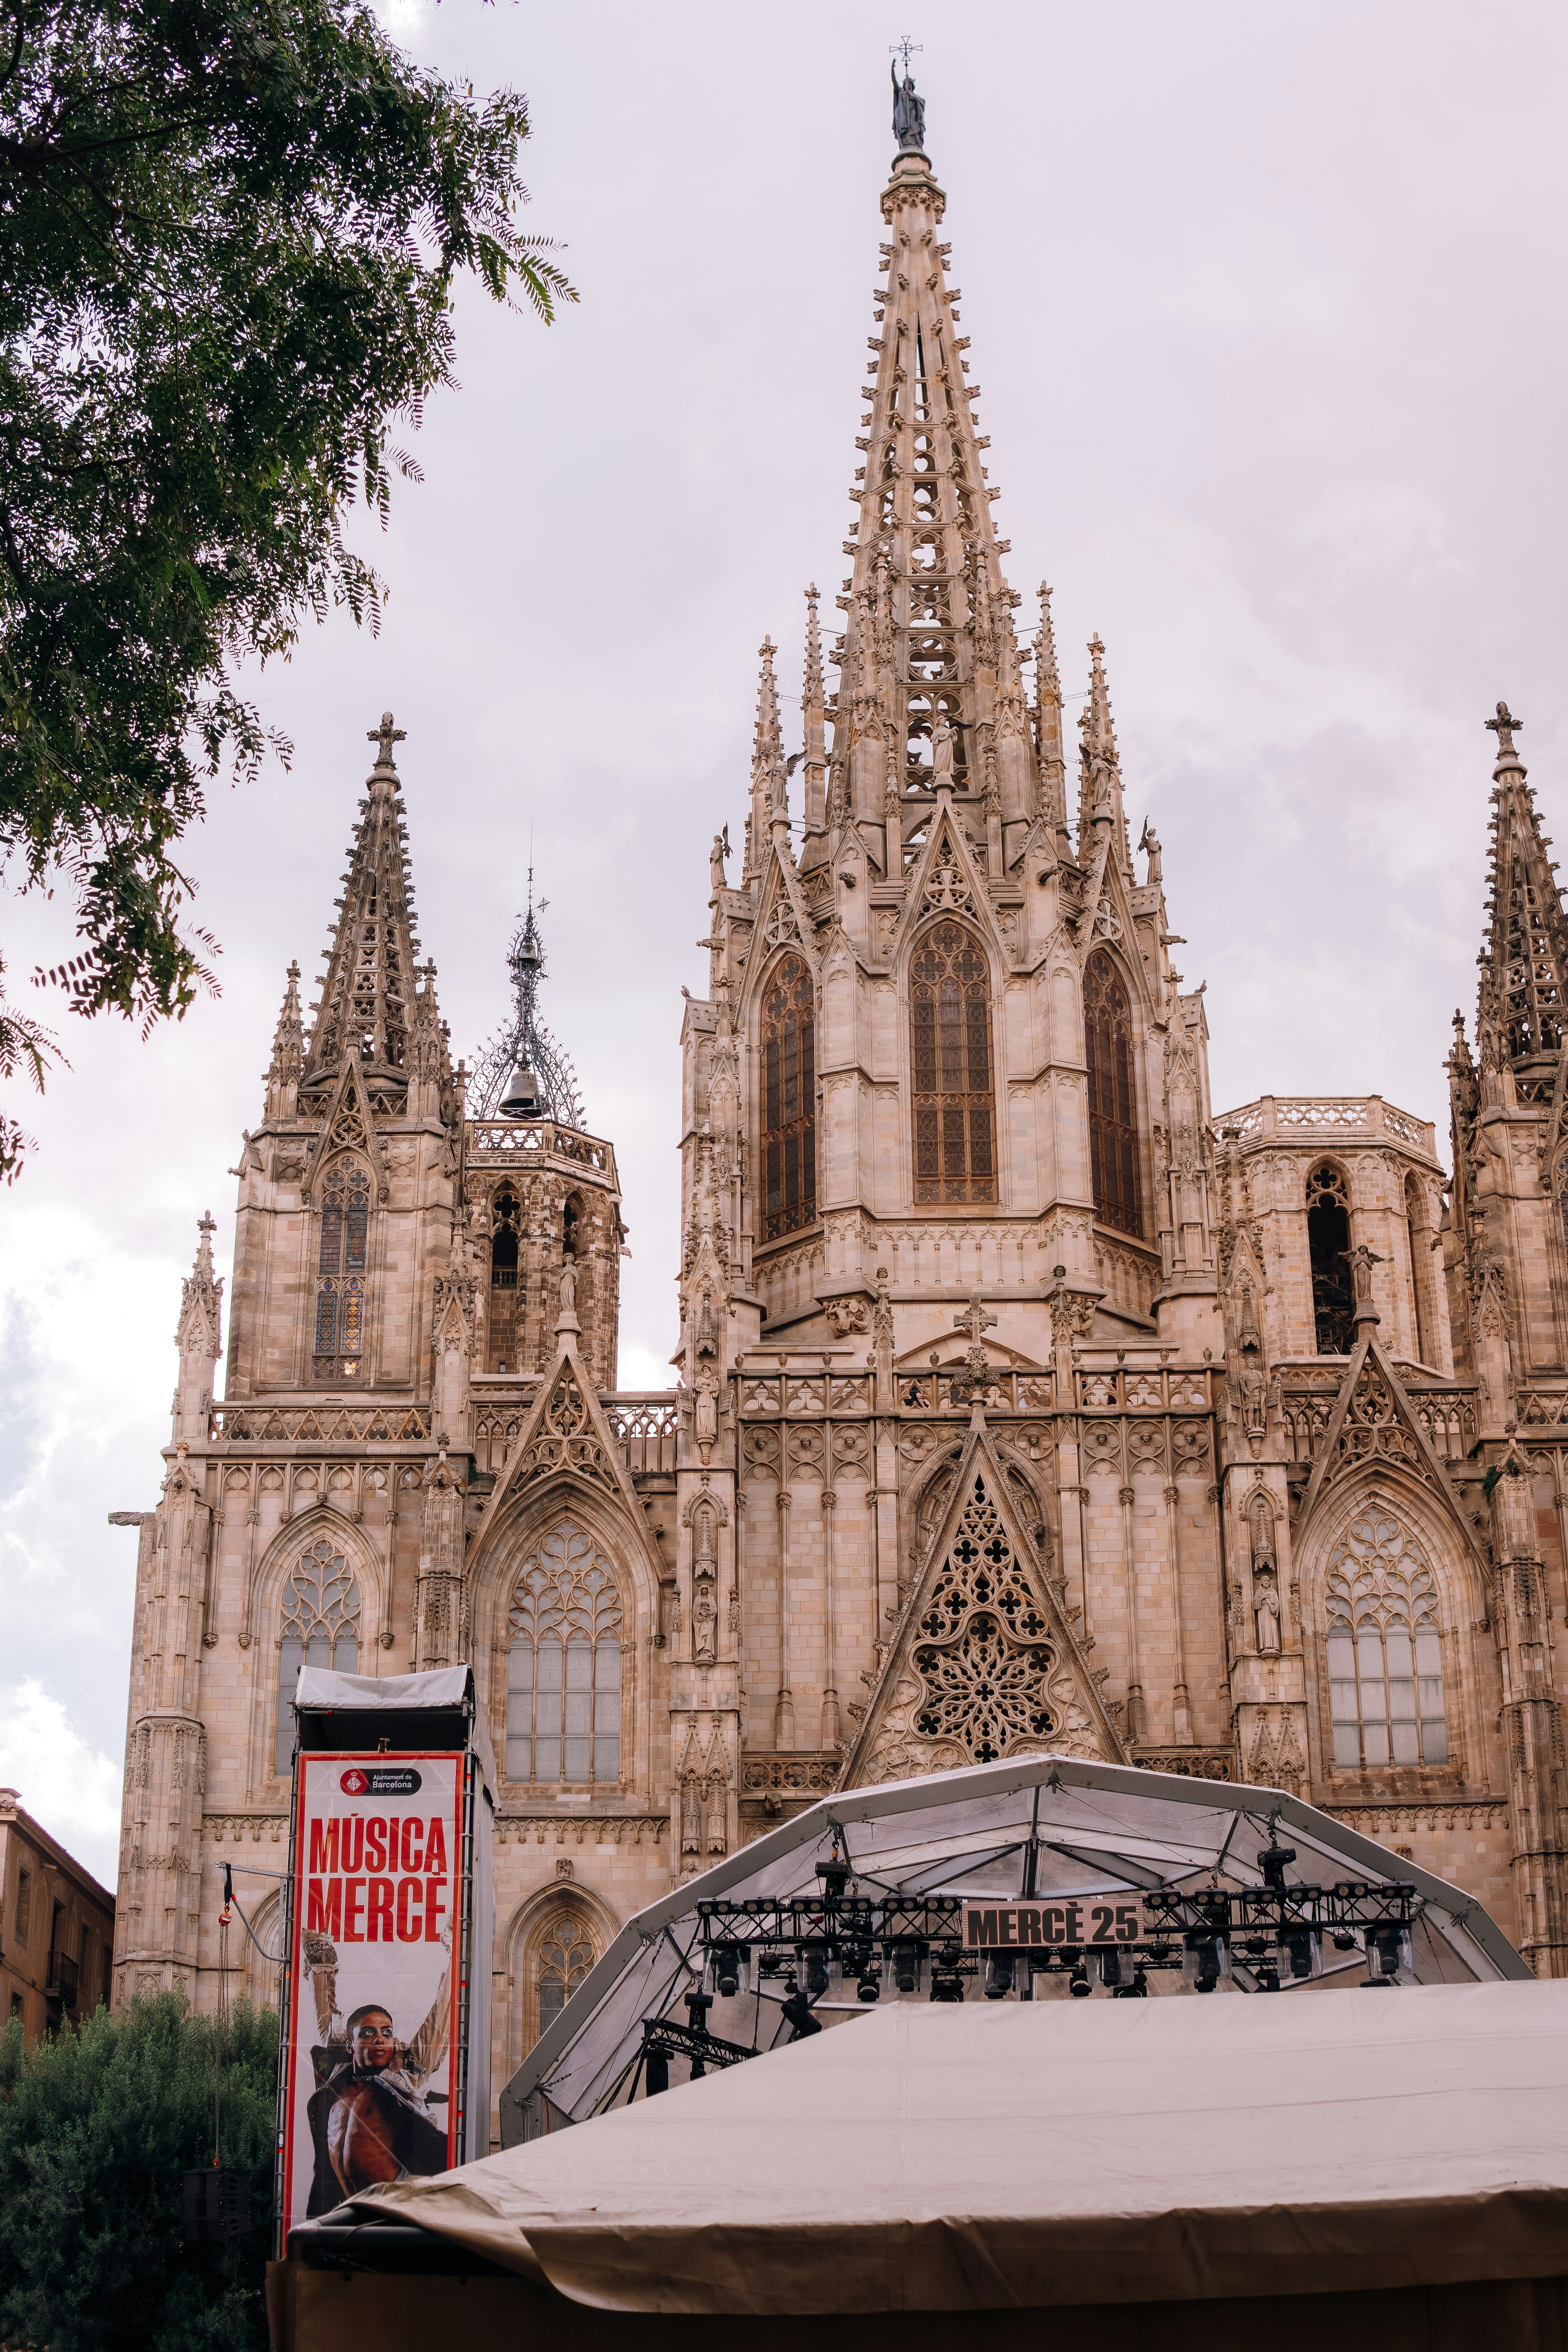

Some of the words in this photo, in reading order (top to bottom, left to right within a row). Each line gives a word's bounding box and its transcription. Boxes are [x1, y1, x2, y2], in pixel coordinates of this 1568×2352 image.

[309, 1813, 447, 1873] MÚSICA
[307, 1872, 447, 1942] MERCÈ
[968, 1901, 1085, 1945] MERCÈ
[1091, 1906, 1138, 1942] 25
